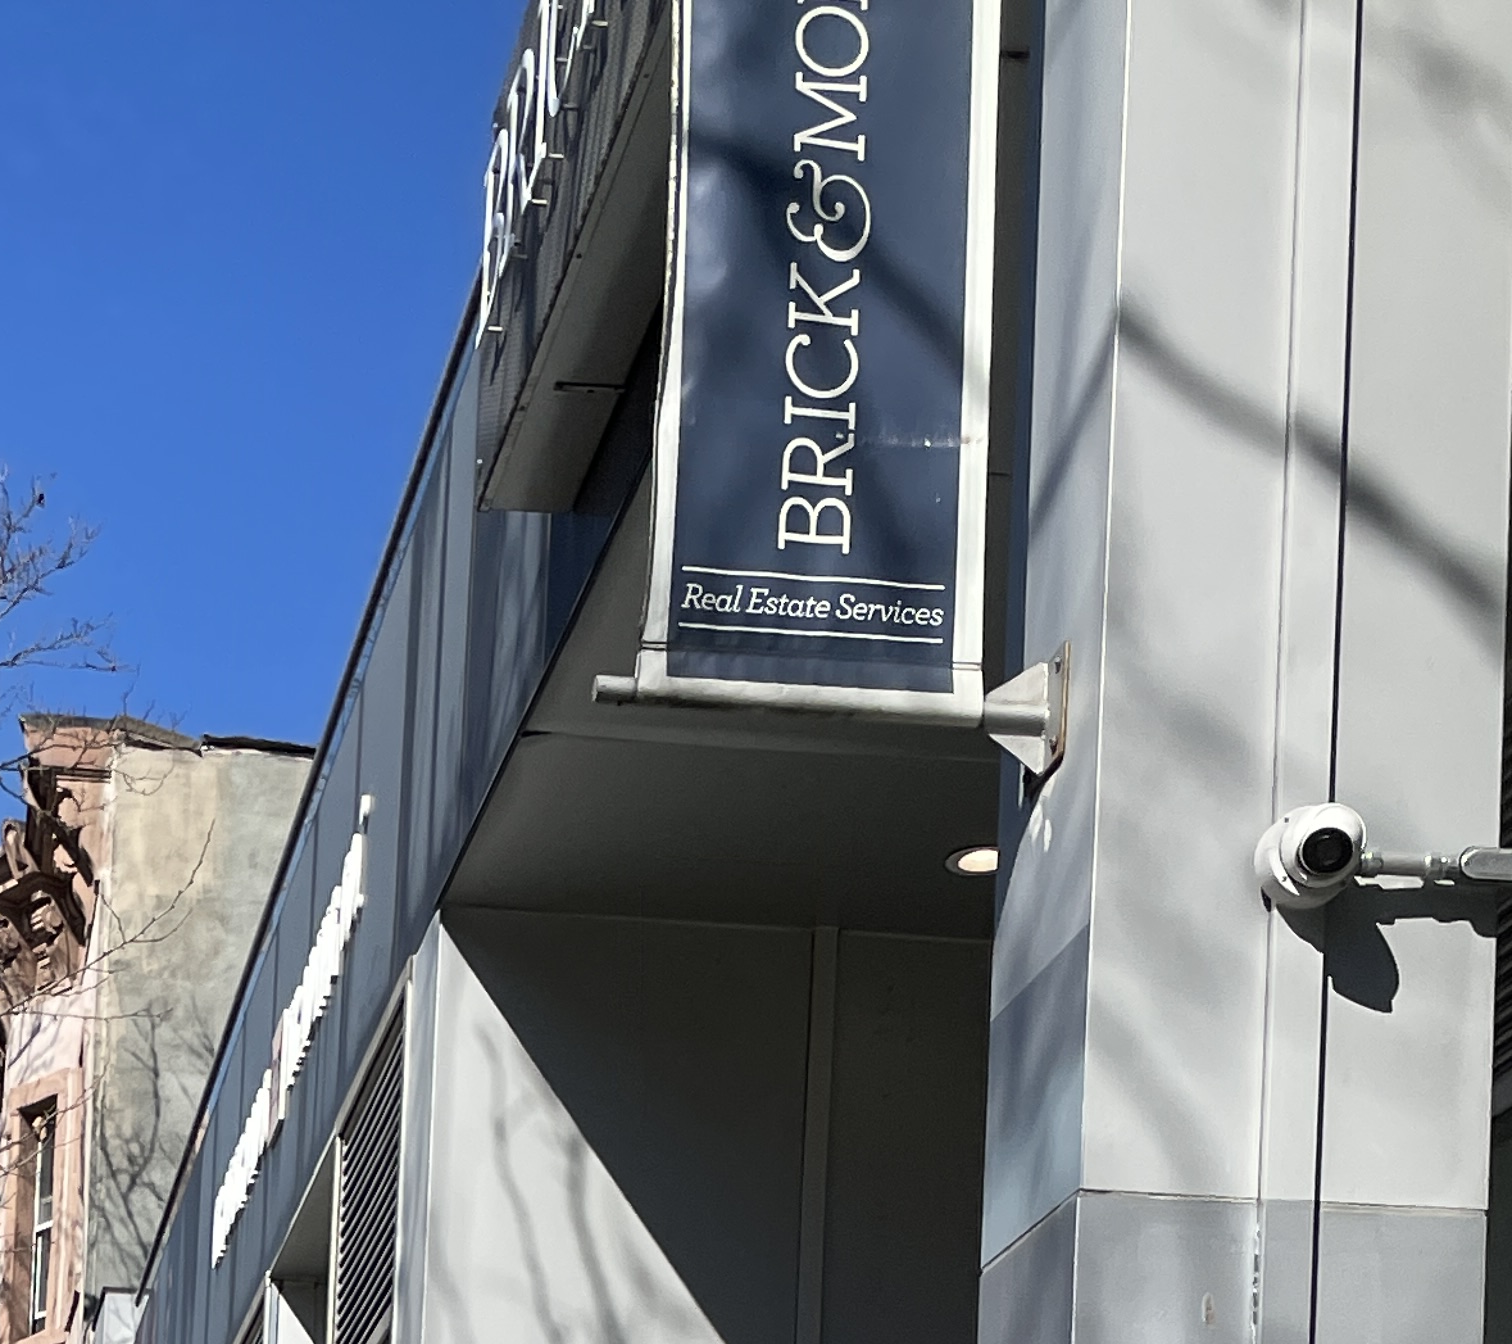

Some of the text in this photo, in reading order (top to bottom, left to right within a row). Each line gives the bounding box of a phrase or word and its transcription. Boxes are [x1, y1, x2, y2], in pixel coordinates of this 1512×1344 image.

[680, 583, 945, 628] Real Estate Services
